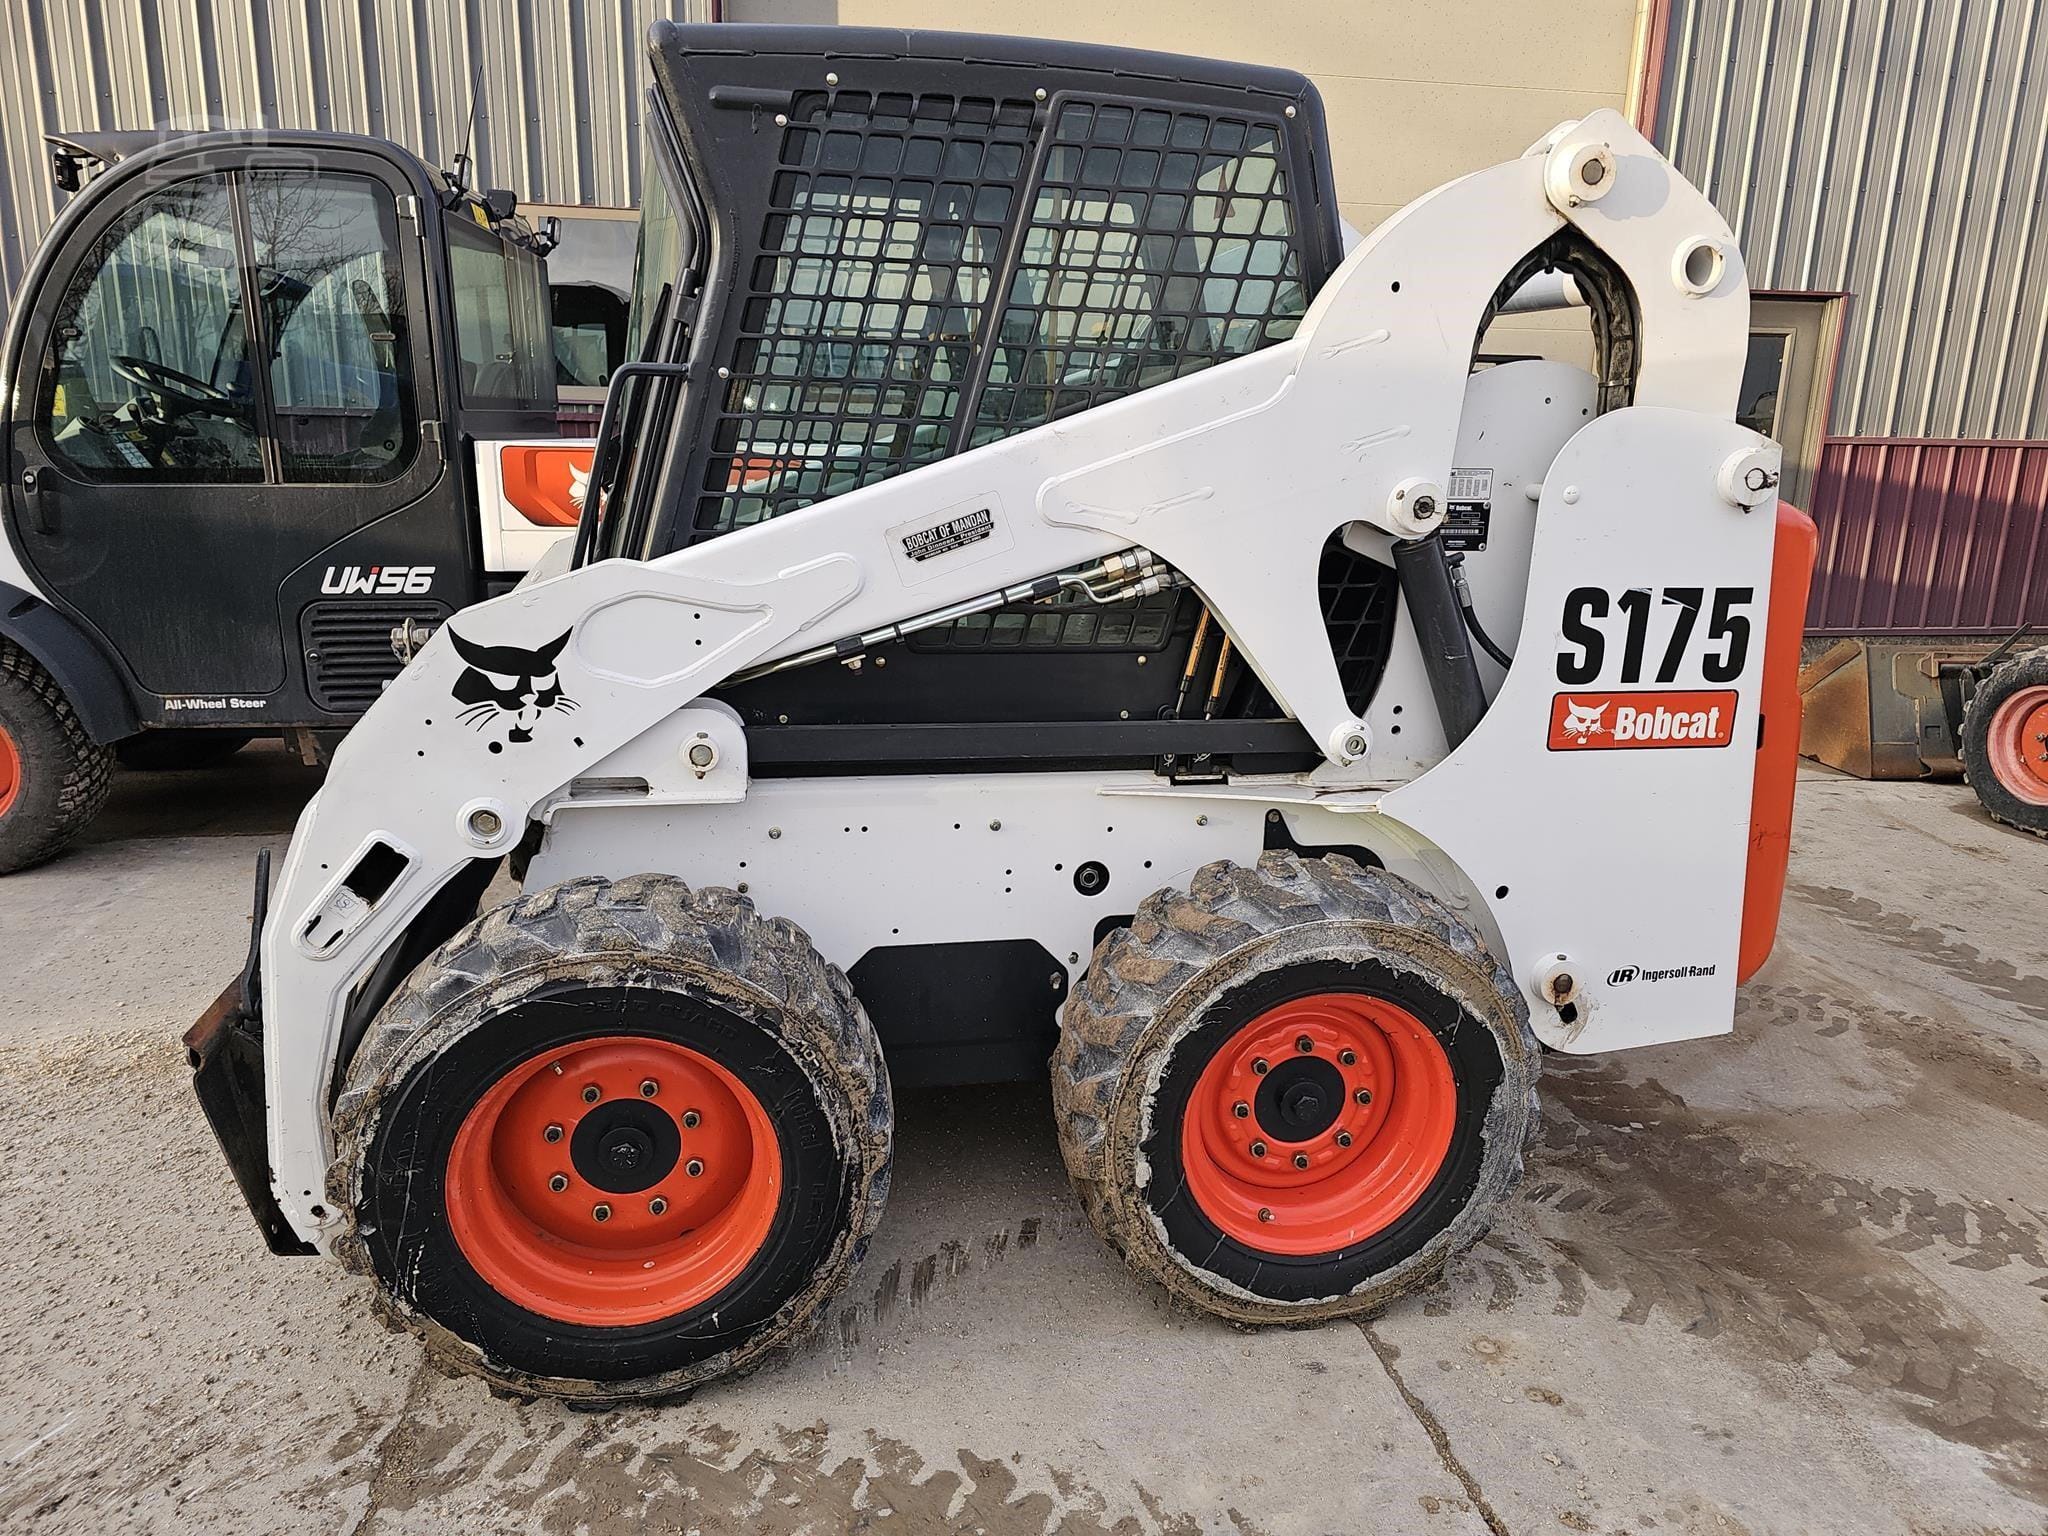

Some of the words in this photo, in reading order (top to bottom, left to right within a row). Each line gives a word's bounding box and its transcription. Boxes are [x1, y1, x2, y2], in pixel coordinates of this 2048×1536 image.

[905, 529, 939, 550] BOBCAT
[940, 523, 951, 538] OF
[951, 510, 989, 533] MANDAN
[960, 523, 992, 540] President
[320, 566, 436, 594] UW56
[1556, 587, 1754, 685] S175
[165, 698, 227, 710] All-Wheel
[229, 697, 267, 709] Steer
[1614, 706, 1720, 740] Bobcat
